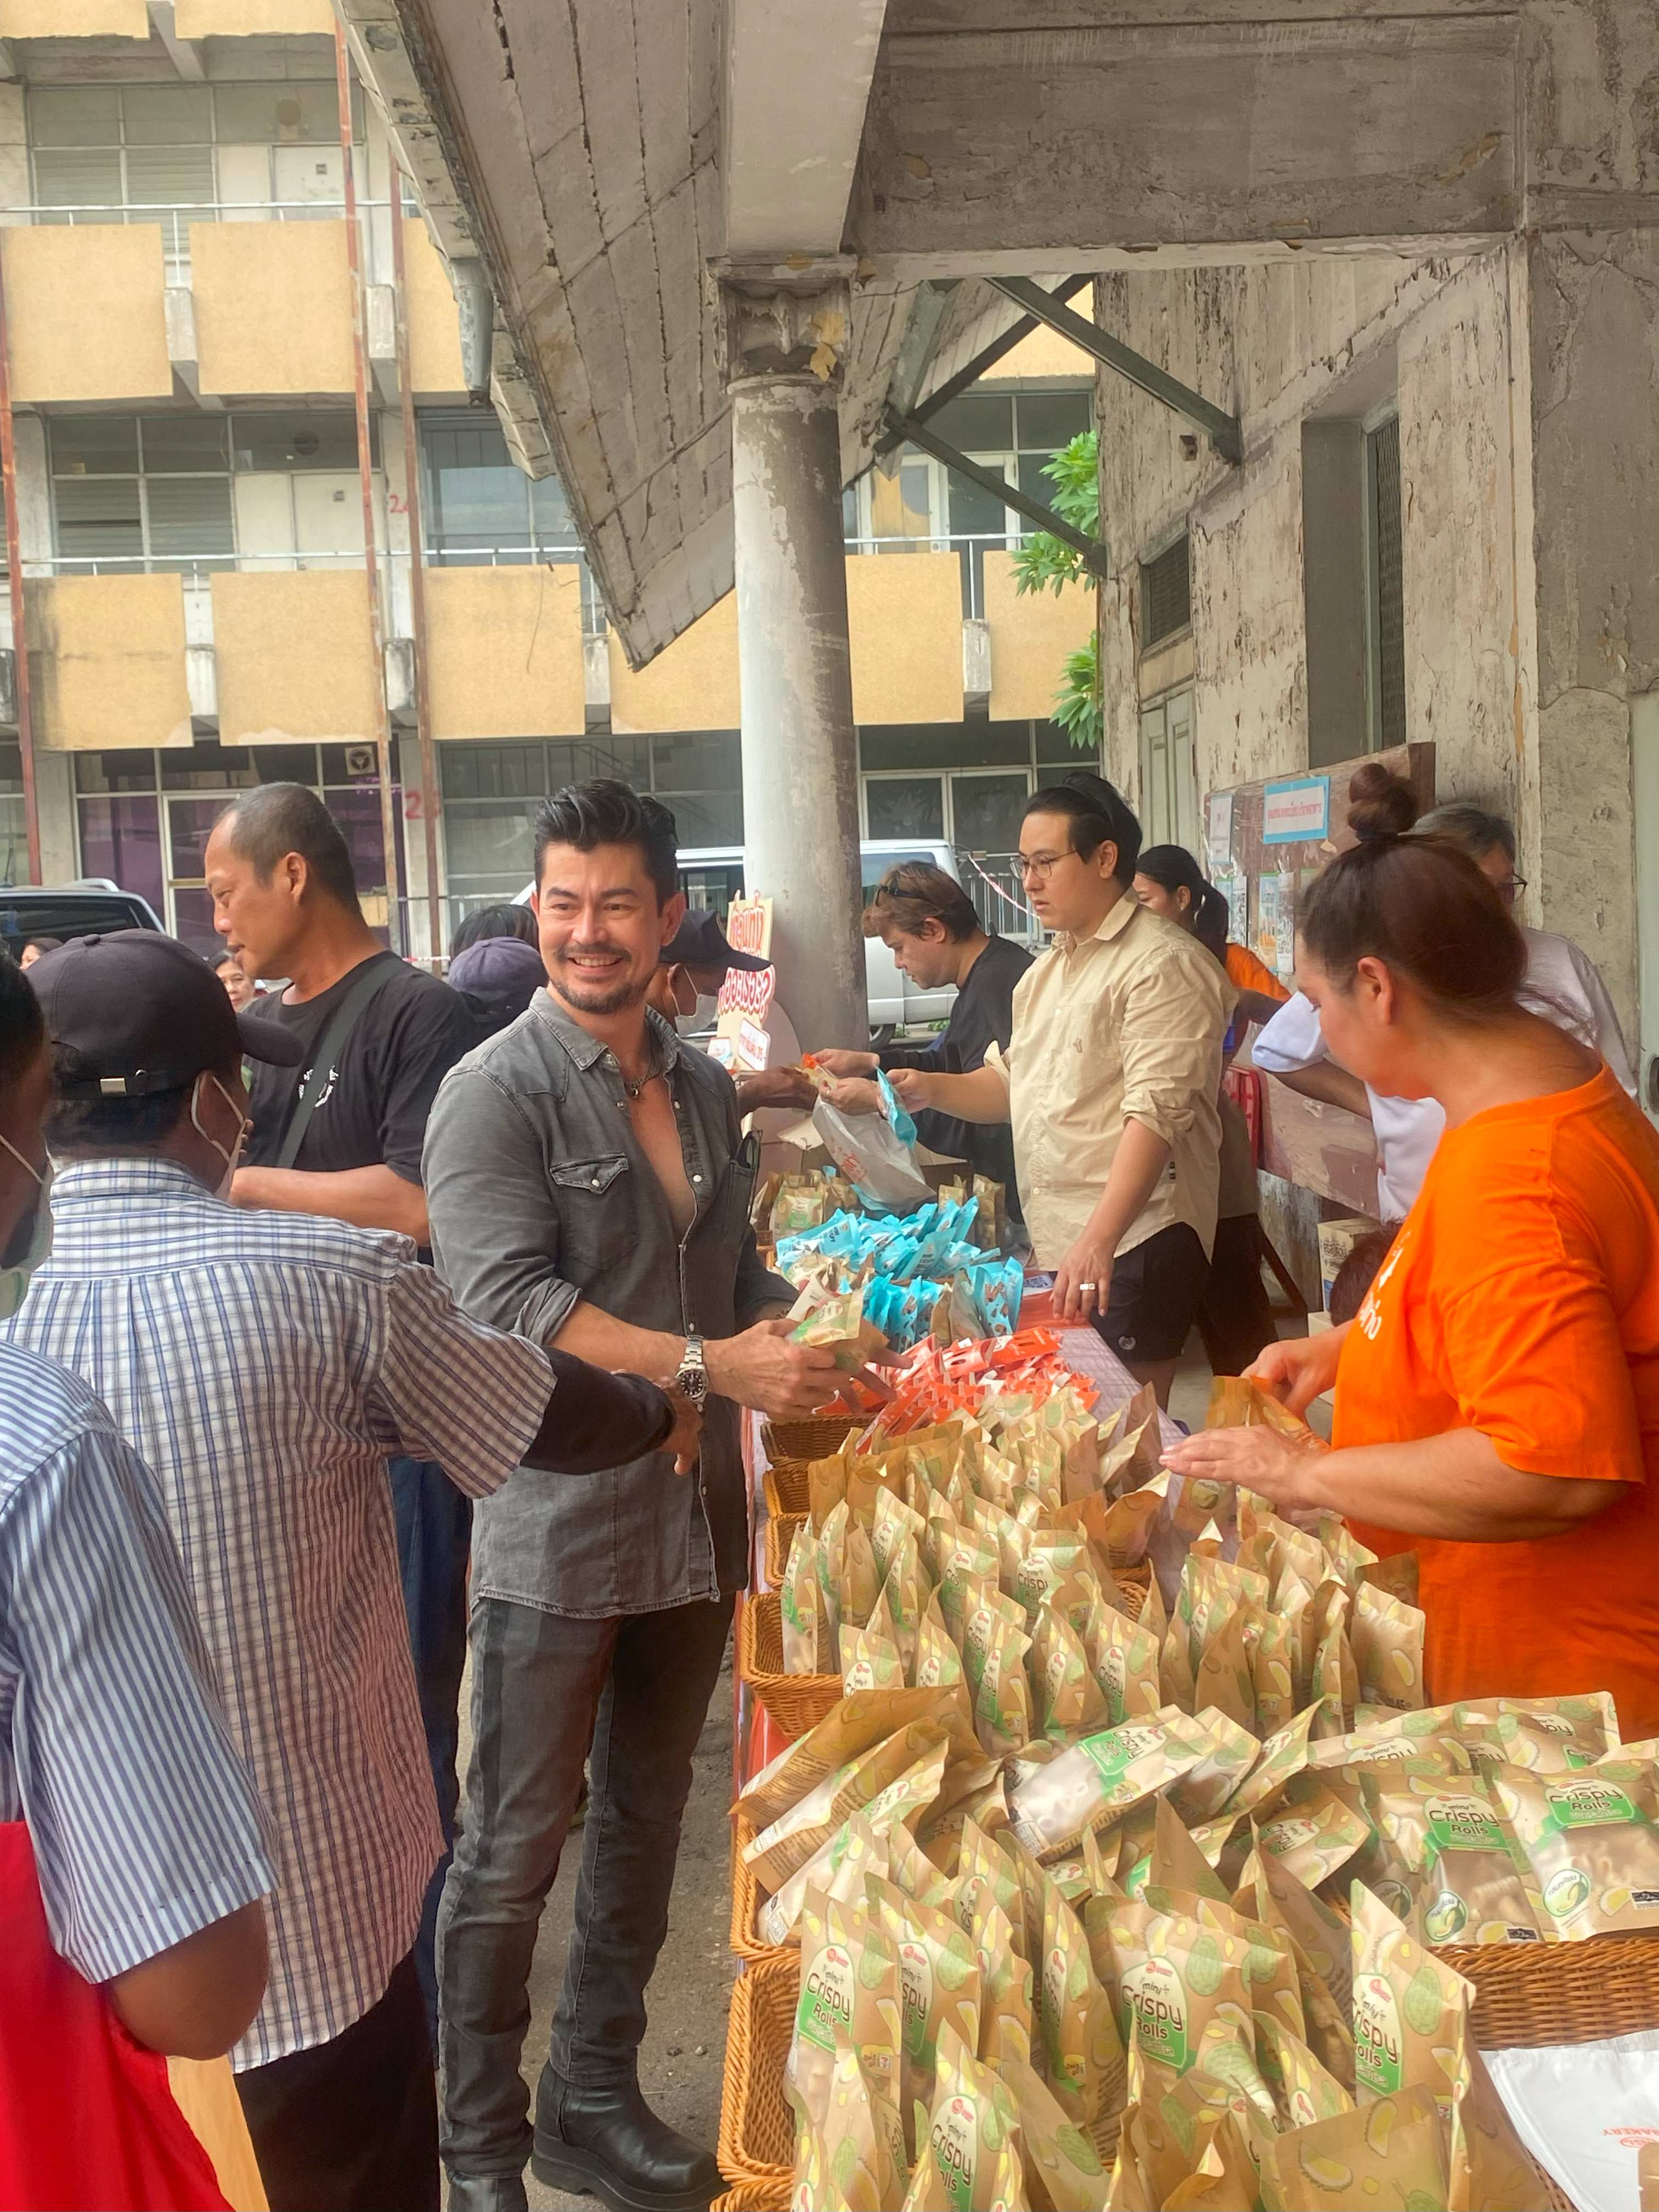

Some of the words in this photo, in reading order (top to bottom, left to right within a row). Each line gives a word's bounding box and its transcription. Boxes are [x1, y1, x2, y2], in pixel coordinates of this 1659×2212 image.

[1549, 1790, 1623, 1803] Crispy
[1572, 1801, 1611, 1810] Rolls
[1429, 1809, 1500, 1827] Crispy
[1451, 1824, 1489, 1835] Rolls
[807, 1972, 850, 2022] Crispy
[902, 1982, 927, 2021] spy
[1122, 1984, 1183, 2032] Crispy
[931, 2124, 972, 2186] Crispy
